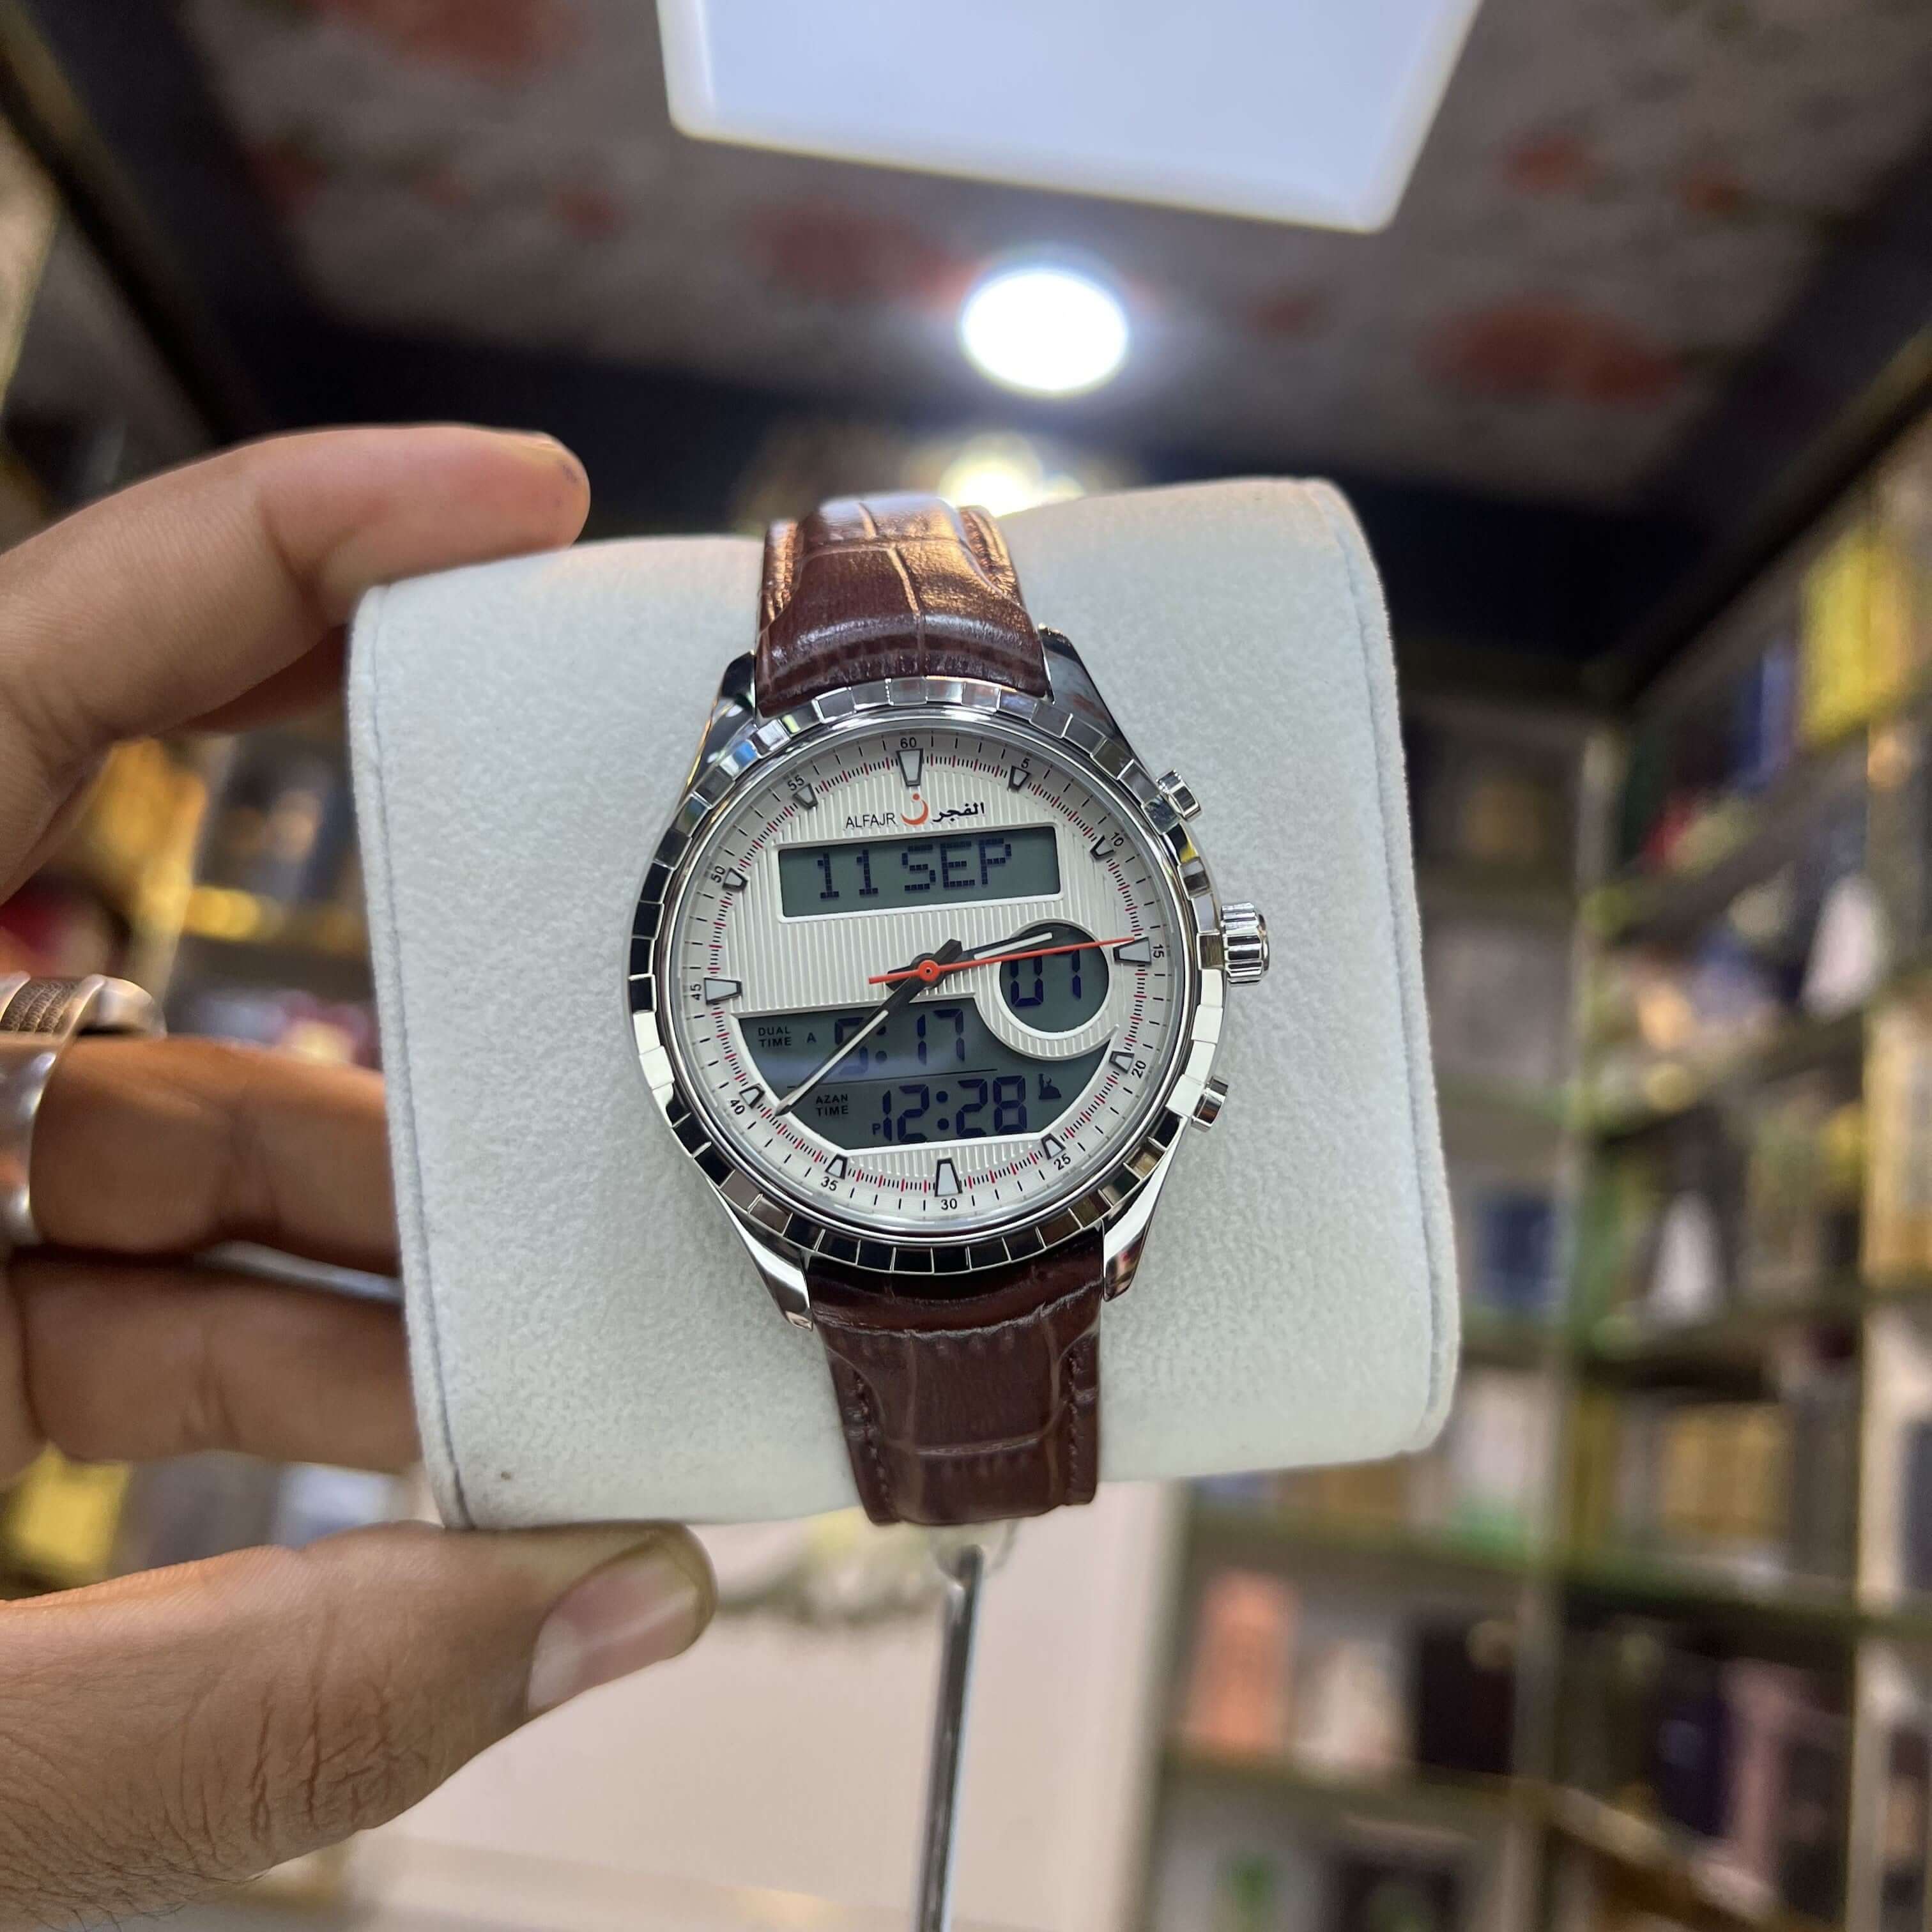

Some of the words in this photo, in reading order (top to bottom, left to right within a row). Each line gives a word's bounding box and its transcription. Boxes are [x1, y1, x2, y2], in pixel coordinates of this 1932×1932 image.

[899, 737, 917, 749] 60
[1020, 757, 1031, 769] 5
[787, 774, 806, 792] 55
[845, 812, 896, 829] ALFAJR
[932, 802, 985, 823] الفجر
[1110, 832, 1124, 847] 10
[710, 865, 726, 884] 50
[817, 848, 878, 900] 11
[901, 837, 1012, 892] SEP
[1152, 944, 1165, 959] 15
[689, 983, 702, 1001] 45
[758, 1025, 792, 1037] DUAL
[806, 1032, 816, 1043] A
[758, 1038, 792, 1048] TIME
[1131, 1060, 1147, 1079] 20
[728, 1098, 746, 1116] 40
[815, 1093, 849, 1105] AZAN
[816, 1105, 850, 1117] TIME
[882, 1075, 1028, 1144] 12:28
[1053, 1153, 1071, 1171] 25
[820, 1176, 839, 1192] 35
[940, 1198, 958, 1210] 30
